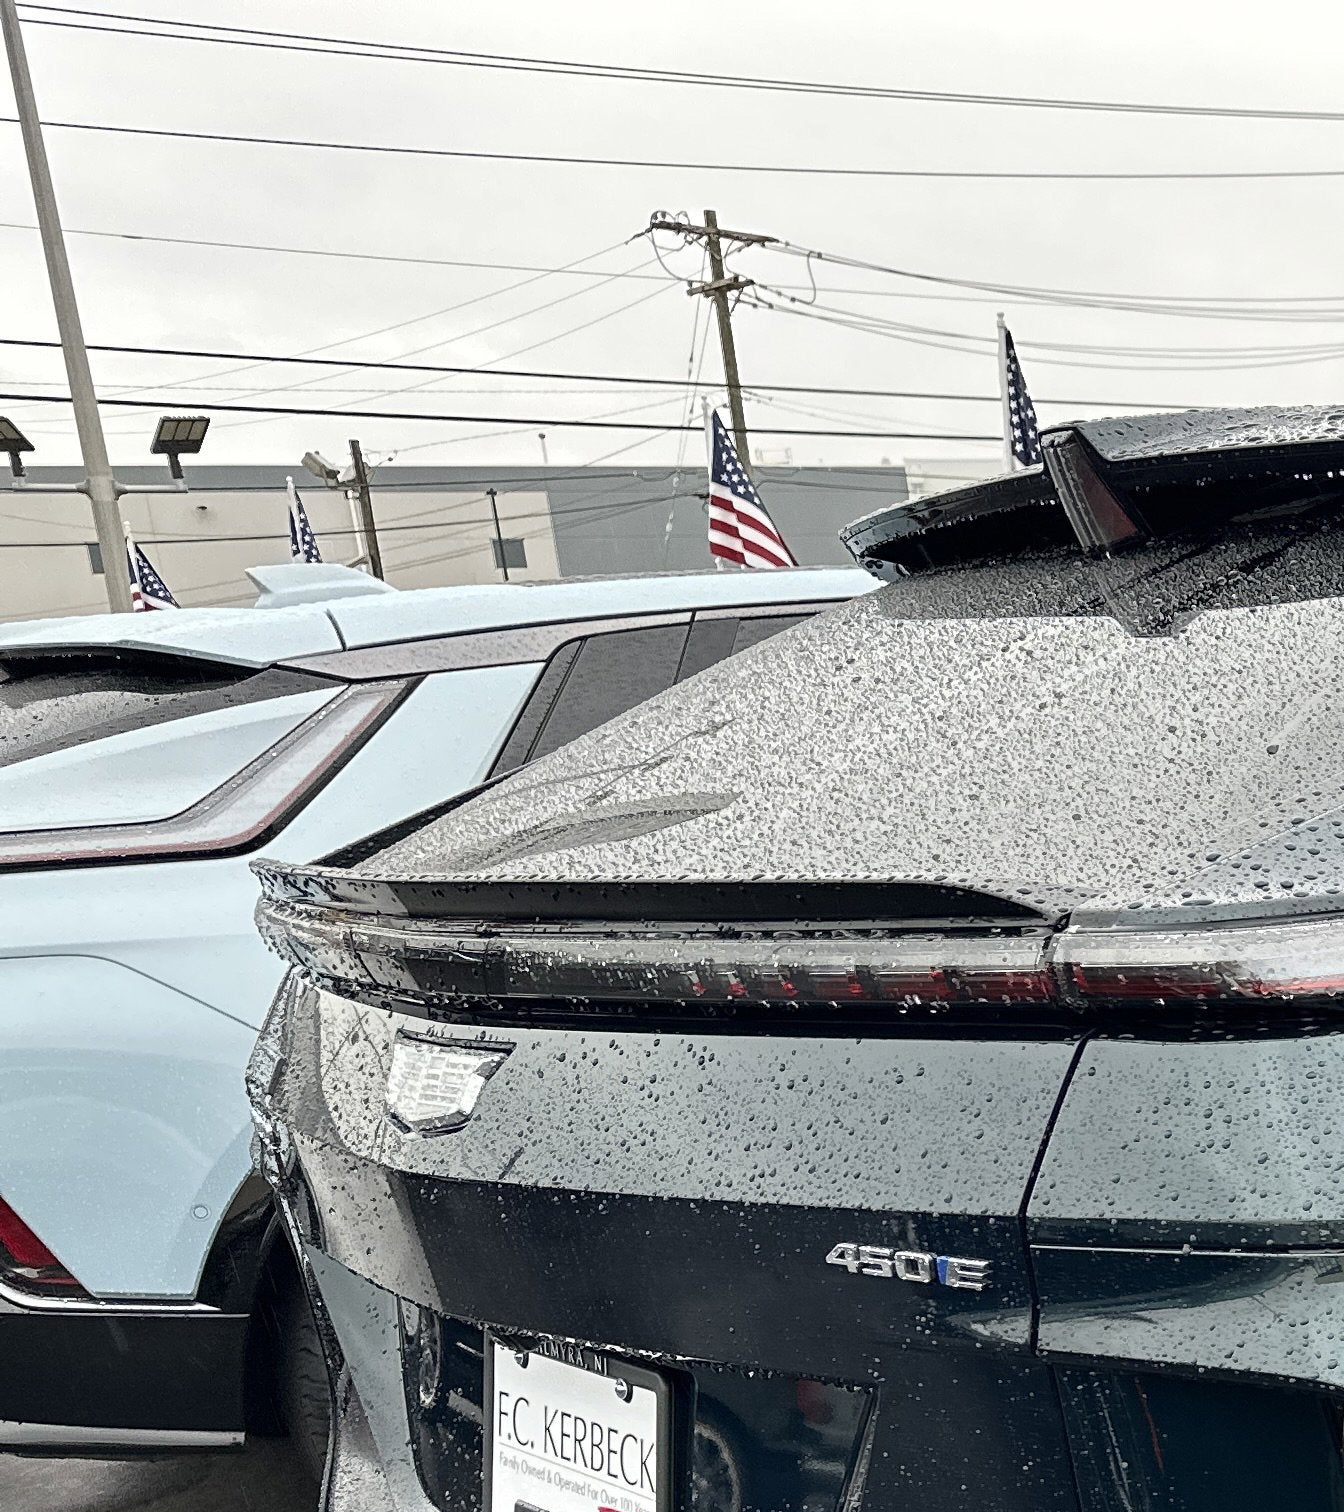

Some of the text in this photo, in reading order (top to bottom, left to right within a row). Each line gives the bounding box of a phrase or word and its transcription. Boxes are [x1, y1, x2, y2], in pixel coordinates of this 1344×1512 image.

[499, 1390, 655, 1494] F.C. KERBECK
[500, 1451, 520, 1473] Family
[521, 1459, 546, 1483] Owned
[553, 1471, 586, 1499] Operated
[587, 1482, 599, 1501] For
[600, 1488, 619, 1508] Over
[620, 1496, 633, 1512] 100
